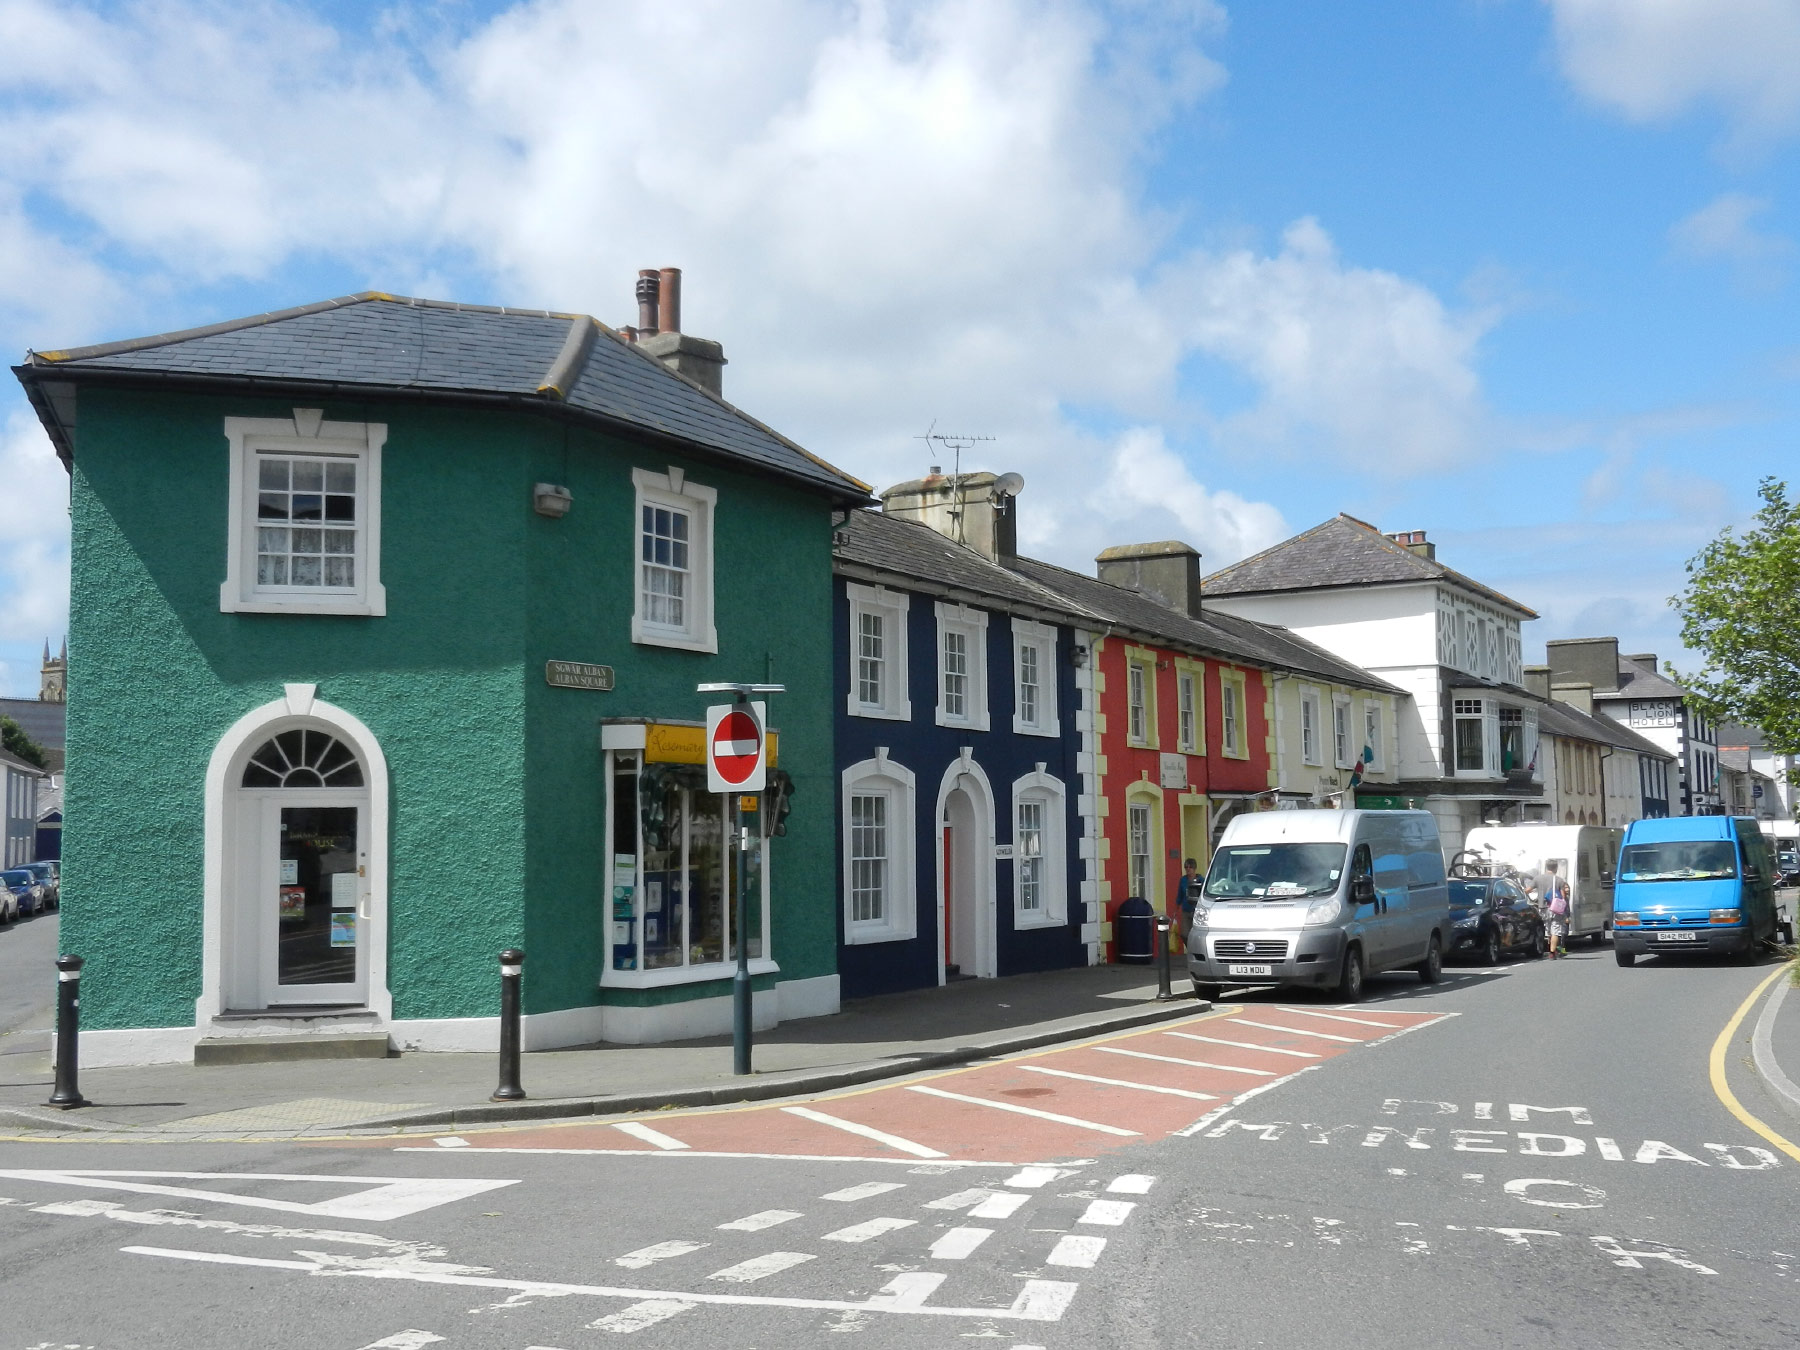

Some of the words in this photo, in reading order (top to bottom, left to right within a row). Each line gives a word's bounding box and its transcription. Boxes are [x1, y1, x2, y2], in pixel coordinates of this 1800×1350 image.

[583, 666, 606, 676] ALBAN
[555, 674, 580, 684] ALBAN
[580, 676, 608, 687] SQUARE
[1632, 702, 1672, 711] BLACK
[1645, 710, 1673, 718] LION
[1632, 717, 1673, 726] HOTEL
[1204, 1119, 1783, 1170] MYNEDIAD
